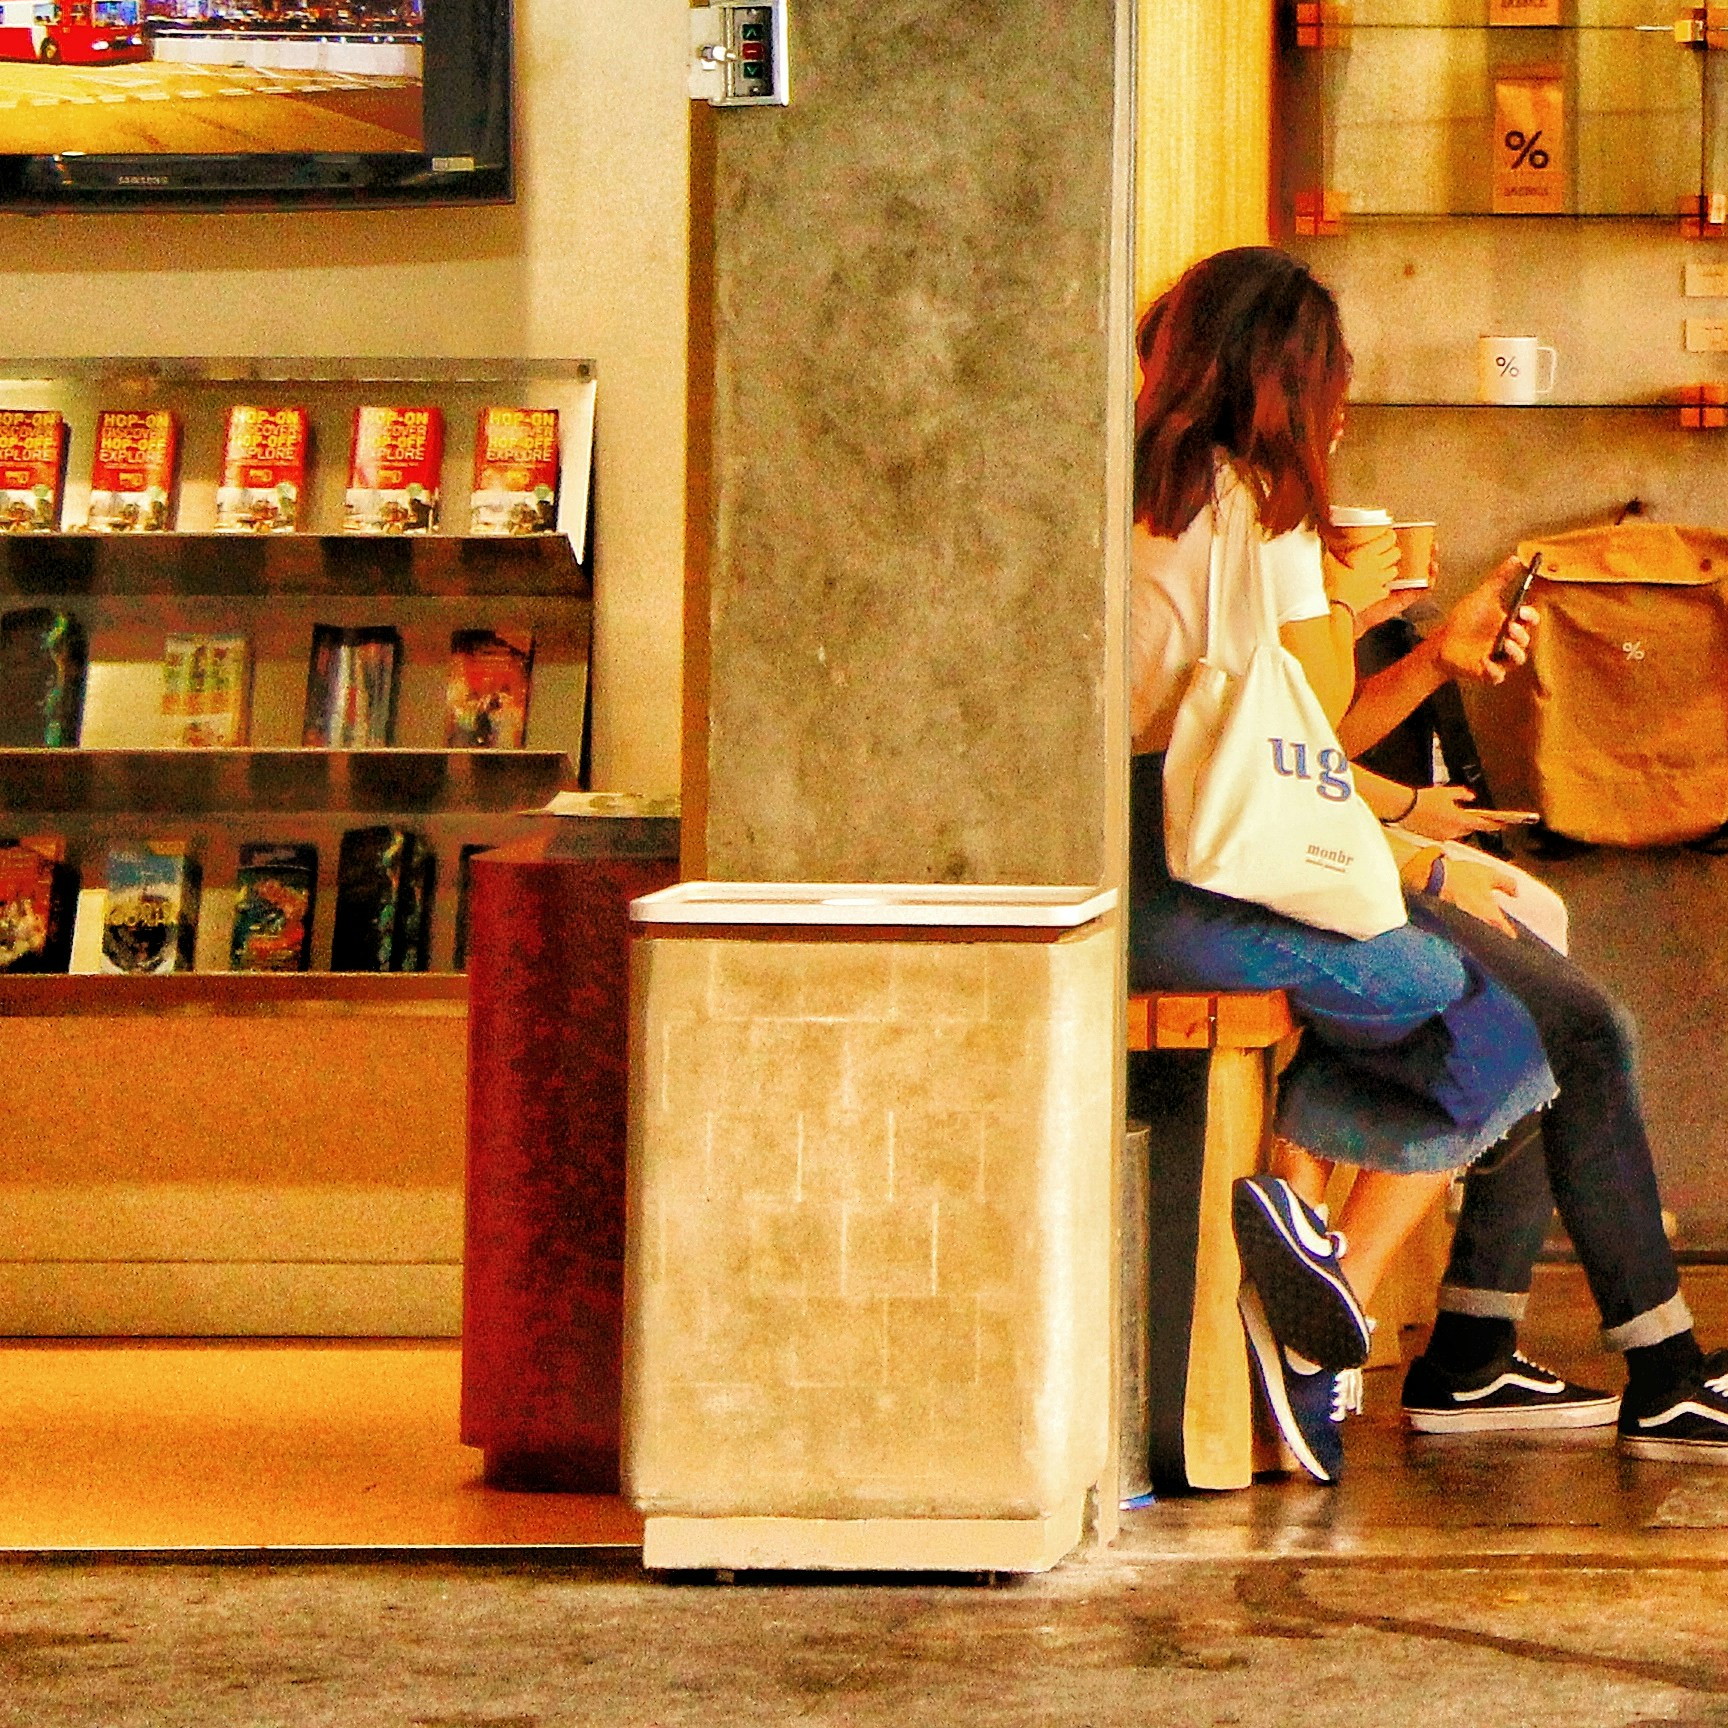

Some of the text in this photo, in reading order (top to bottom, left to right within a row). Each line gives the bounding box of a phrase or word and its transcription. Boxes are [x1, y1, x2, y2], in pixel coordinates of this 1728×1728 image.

[1504, 130, 1549, 169] %
[103, 413, 170, 427] HOP-ON
[0, 437, 56, 449] OP-OFF
[101, 437, 167, 452] HOP-OFF
[99, 449, 165, 463] EXPLORE
[1267, 737, 1352, 803] ug
